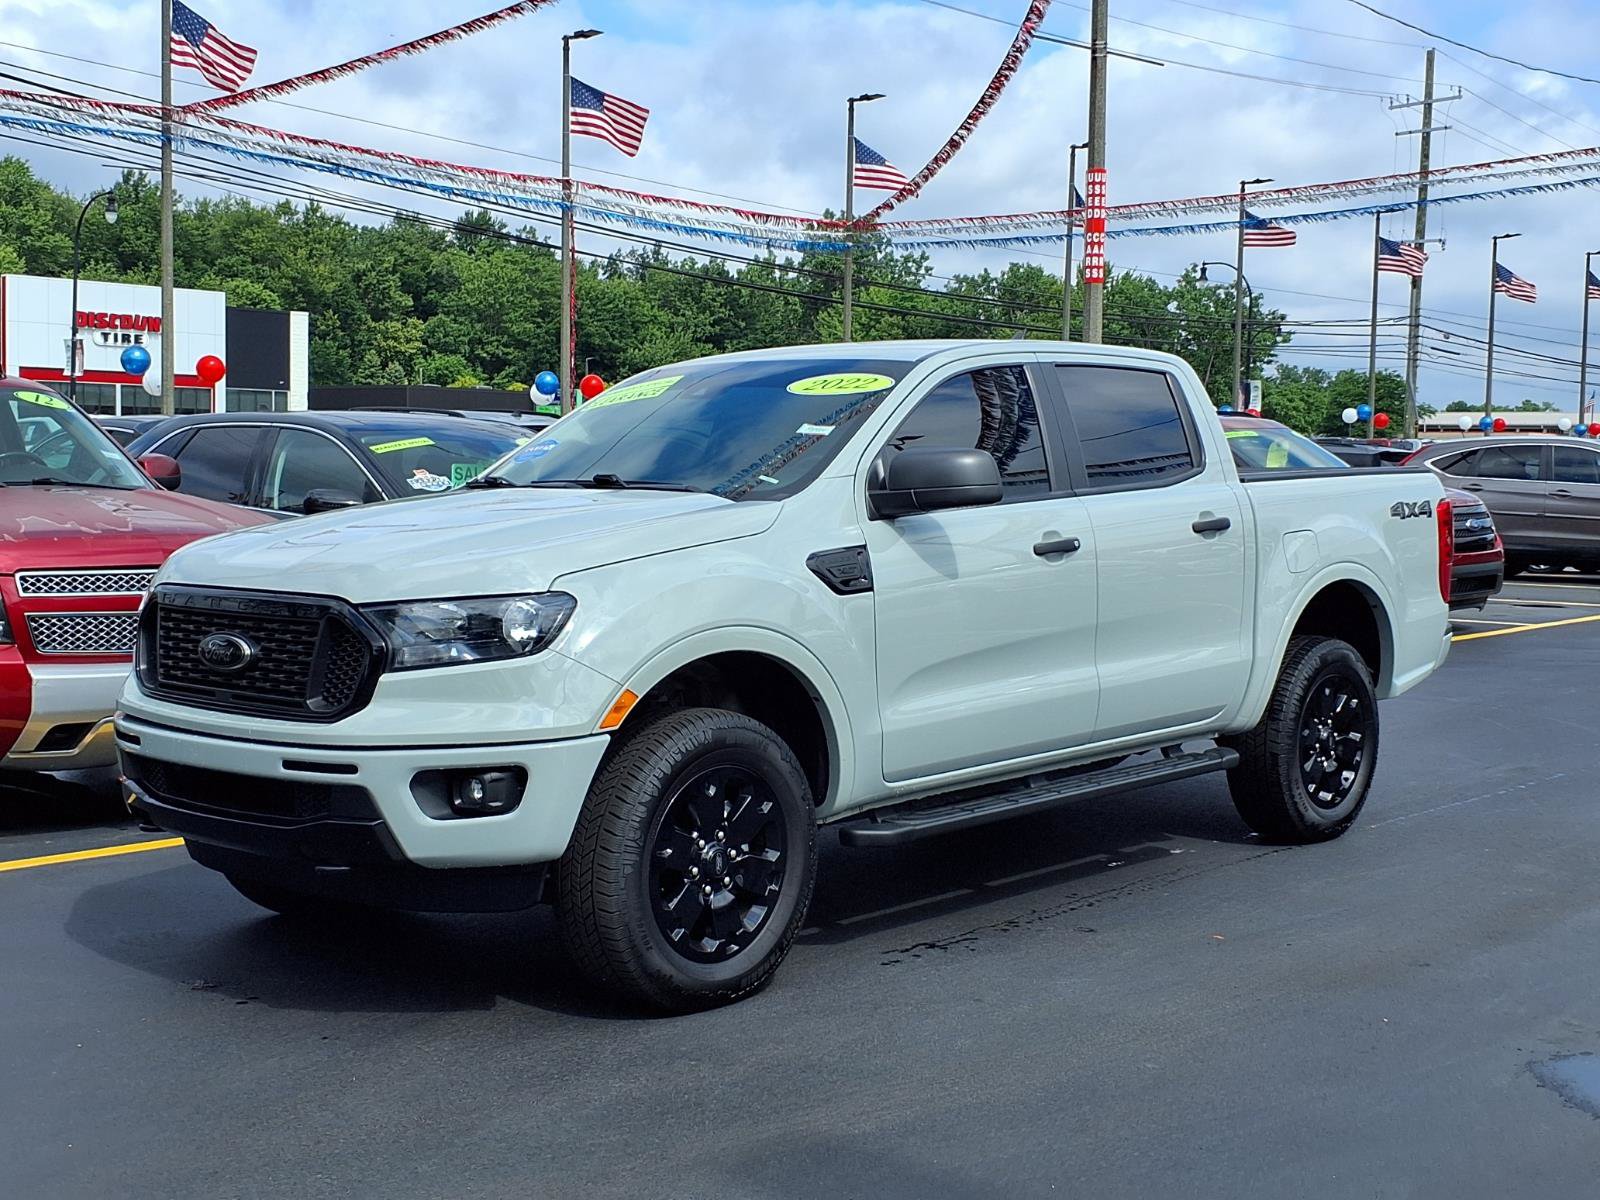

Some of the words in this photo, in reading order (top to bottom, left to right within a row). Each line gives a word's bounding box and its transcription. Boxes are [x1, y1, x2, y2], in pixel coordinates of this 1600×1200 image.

[76, 310, 161, 332] DISCOUN
[101, 331, 144, 345] TIRE
[803, 377, 879, 391] 2022
[454, 466, 484, 481] SAL
[205, 640, 233, 664] Ford
